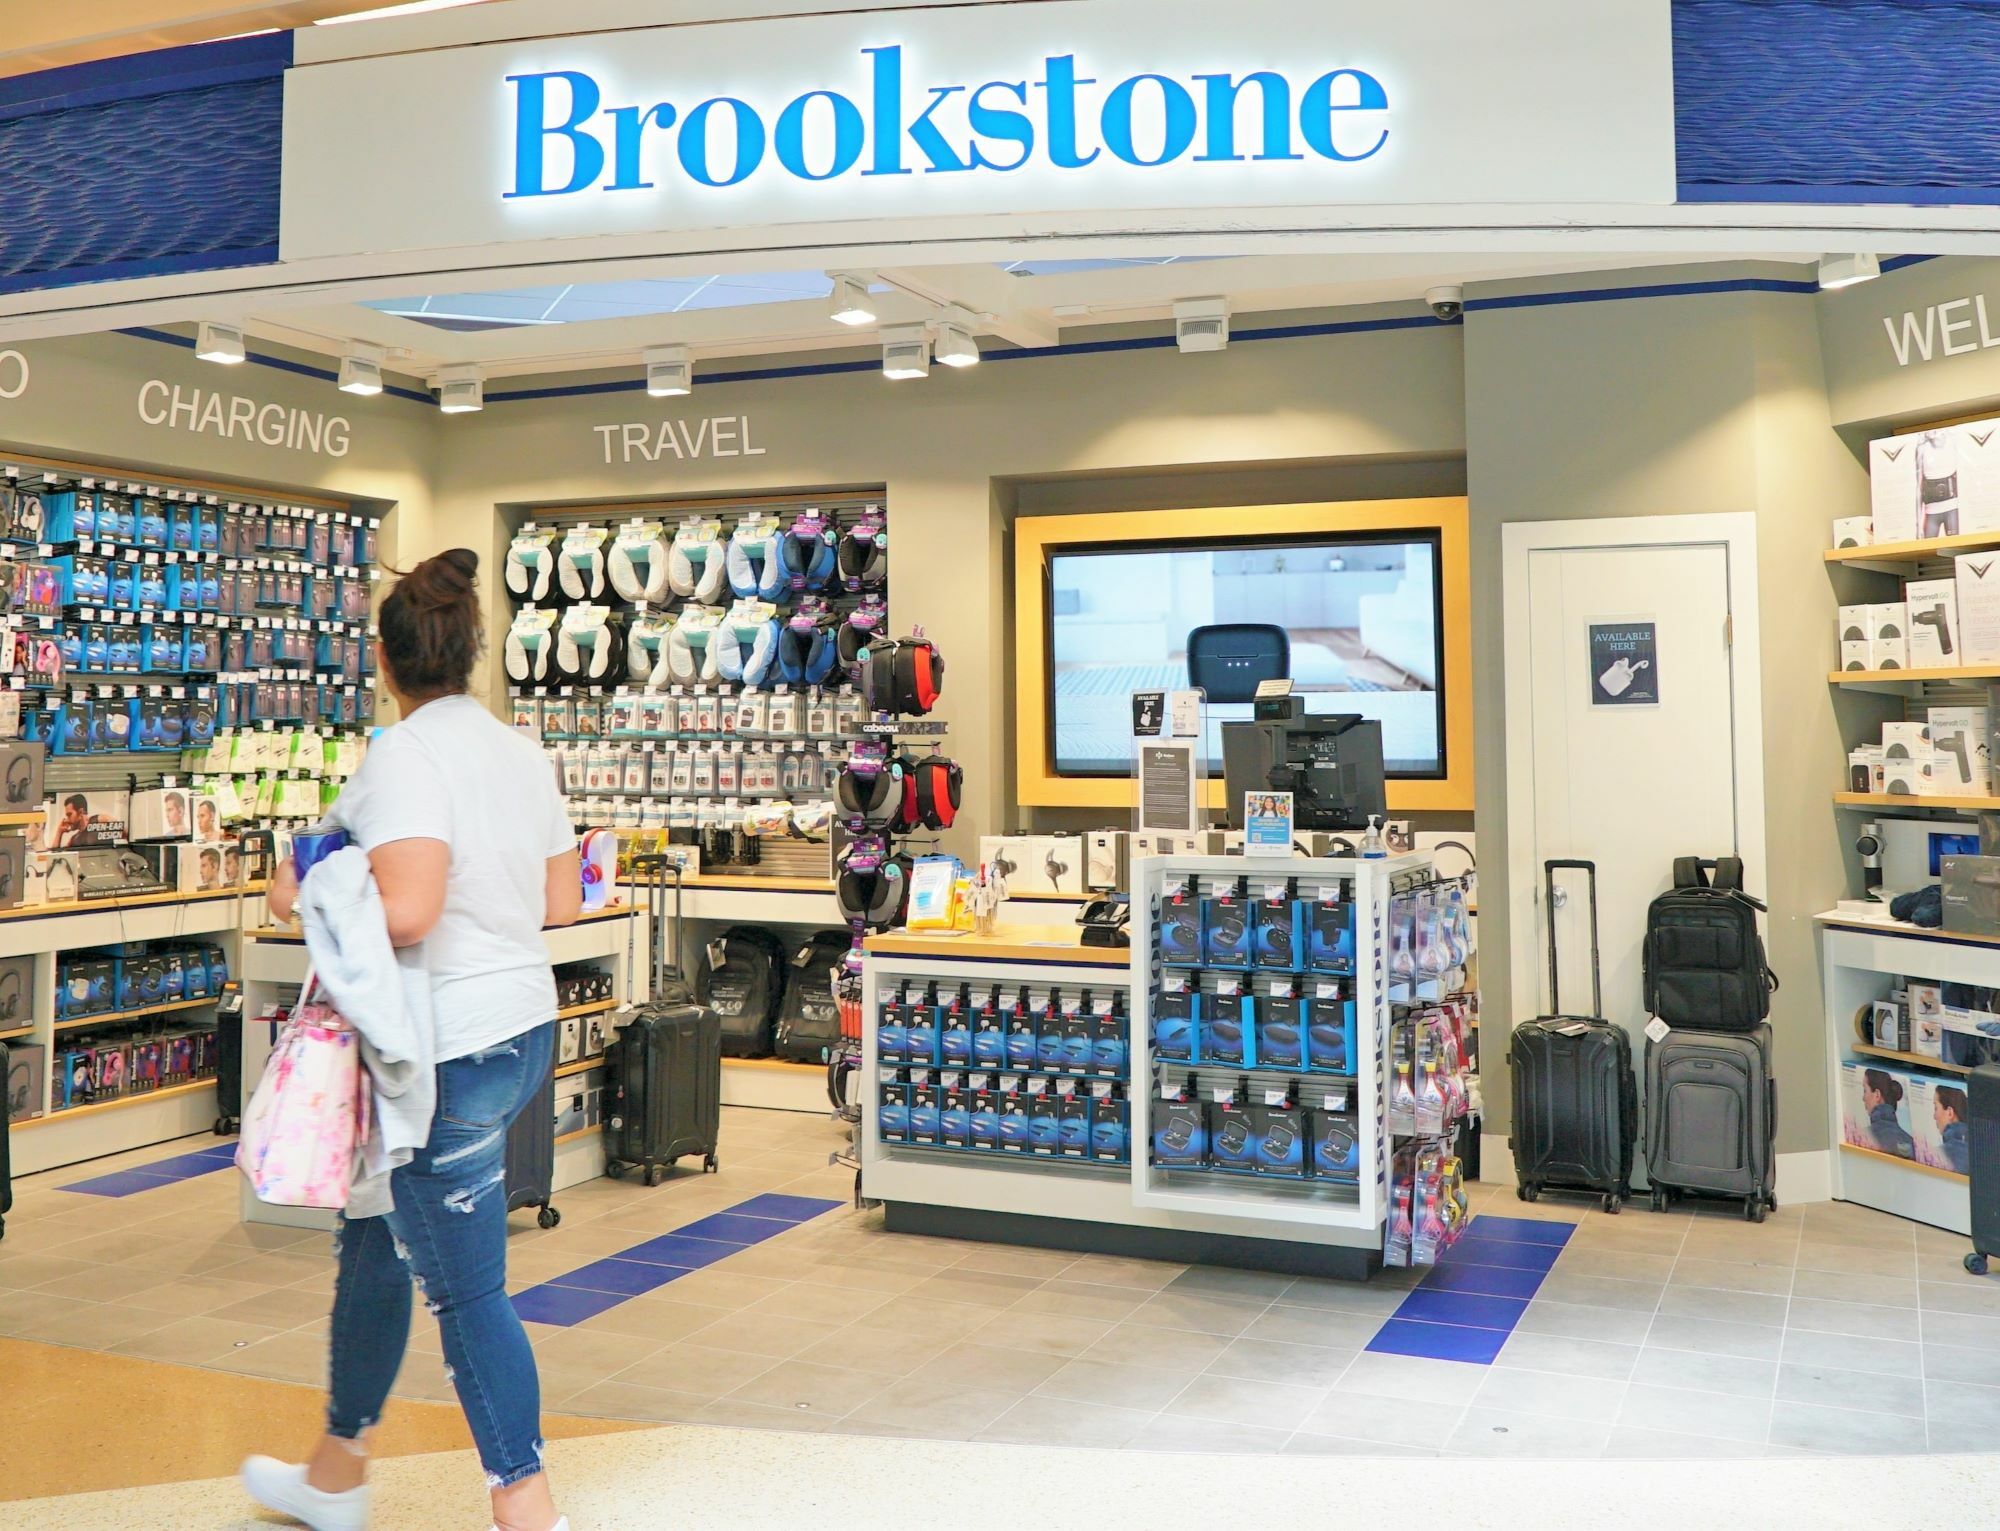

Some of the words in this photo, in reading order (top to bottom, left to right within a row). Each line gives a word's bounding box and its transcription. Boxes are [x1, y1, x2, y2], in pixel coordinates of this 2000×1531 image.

[503, 45, 1390, 198] Brookstone
[138, 379, 351, 457] CHARGING
[593, 415, 766, 464] TRAVEL
[1594, 632, 1651, 642] AVAILABLE
[1610, 642, 1636, 650] HERE
[863, 724, 899, 733] cabeau
[87, 822, 124, 832] OPEN-EAR
[98, 831, 122, 840] DESIGN
